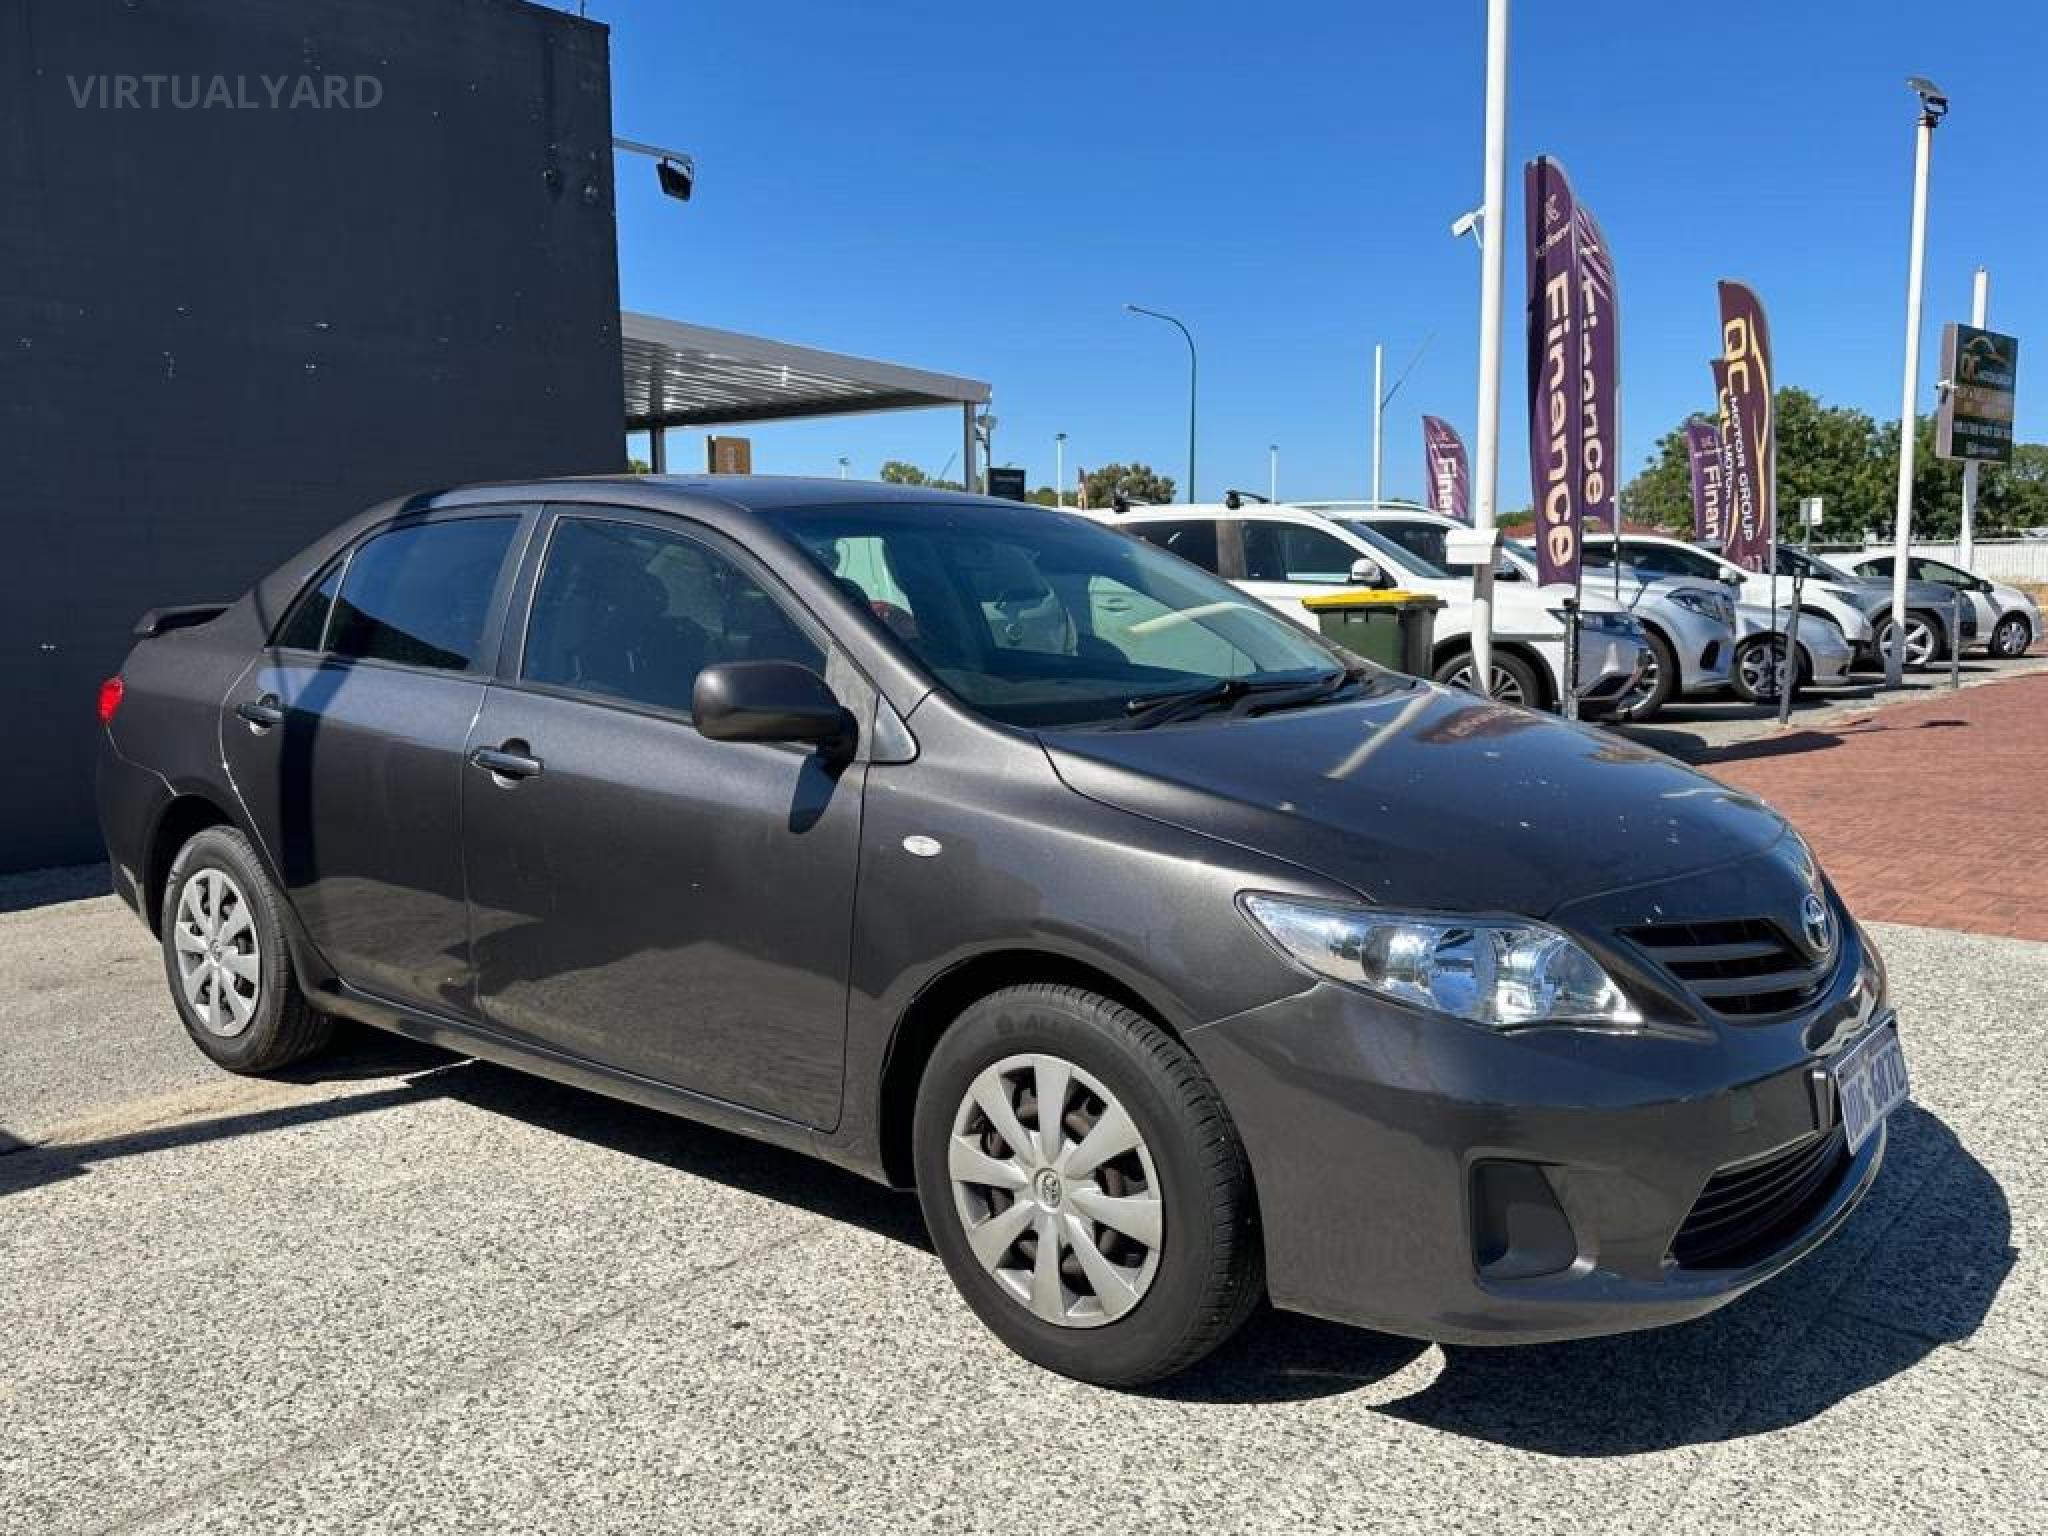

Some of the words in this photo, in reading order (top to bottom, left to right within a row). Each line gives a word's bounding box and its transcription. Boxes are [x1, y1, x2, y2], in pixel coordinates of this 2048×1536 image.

[1546, 271, 1574, 567] Finance
[1724, 317, 1750, 395] QC
[1729, 397, 1745, 468] MOTOR
[1738, 472, 1754, 541] GROUP
